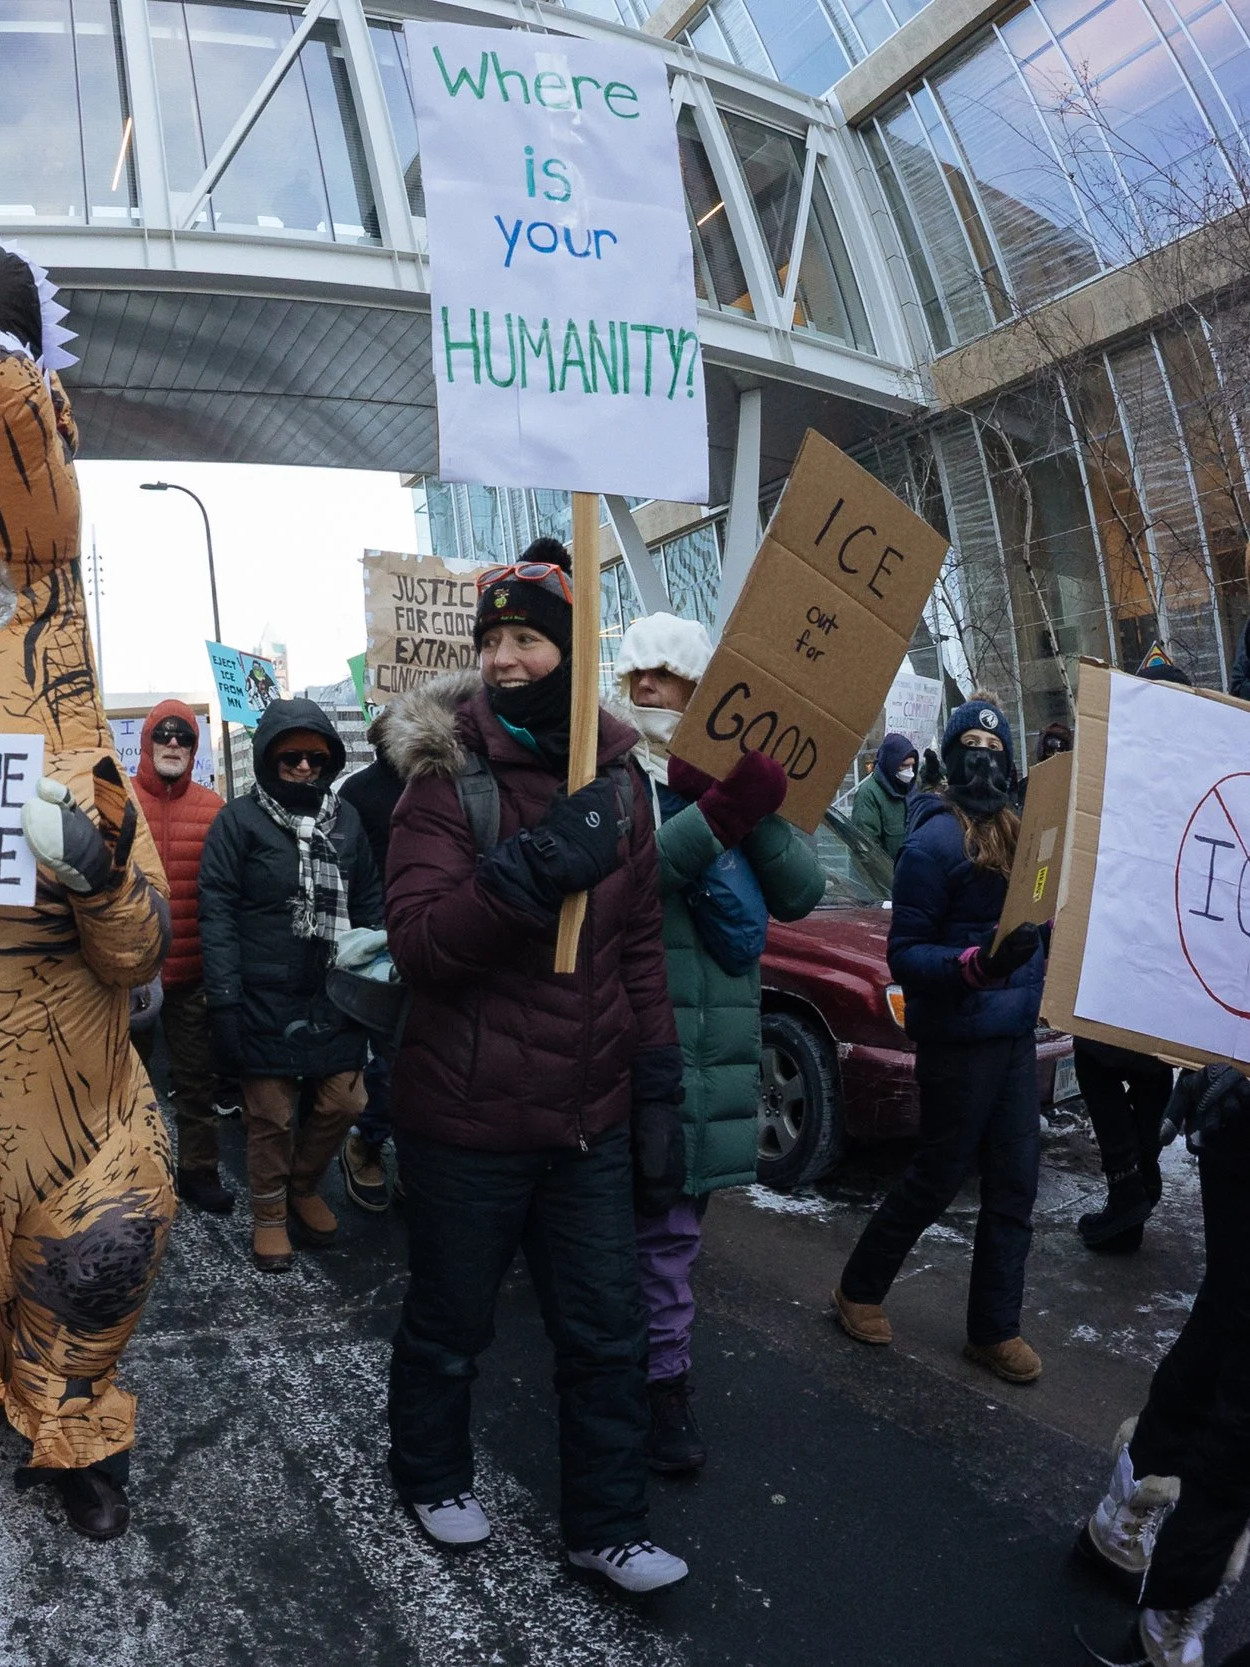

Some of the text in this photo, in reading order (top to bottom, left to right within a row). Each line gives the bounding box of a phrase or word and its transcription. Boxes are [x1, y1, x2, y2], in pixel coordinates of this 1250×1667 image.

[432, 45, 640, 120] Where
[524, 145, 572, 203] is
[494, 214, 618, 268] your
[441, 306, 700, 400] HUMANITY?
[813, 497, 905, 600] ICE
[392, 575, 476, 608] JUSTIC
[394, 606, 429, 634] FOR
[395, 636, 481, 670] EXTRADI
[796, 628, 827, 662] for
[212, 655, 237, 670] EJECT
[220, 670, 236, 682] ICE
[218, 682, 245, 697] FROM
[227, 697, 242, 709] MN
[704, 681, 819, 782] GOOD
